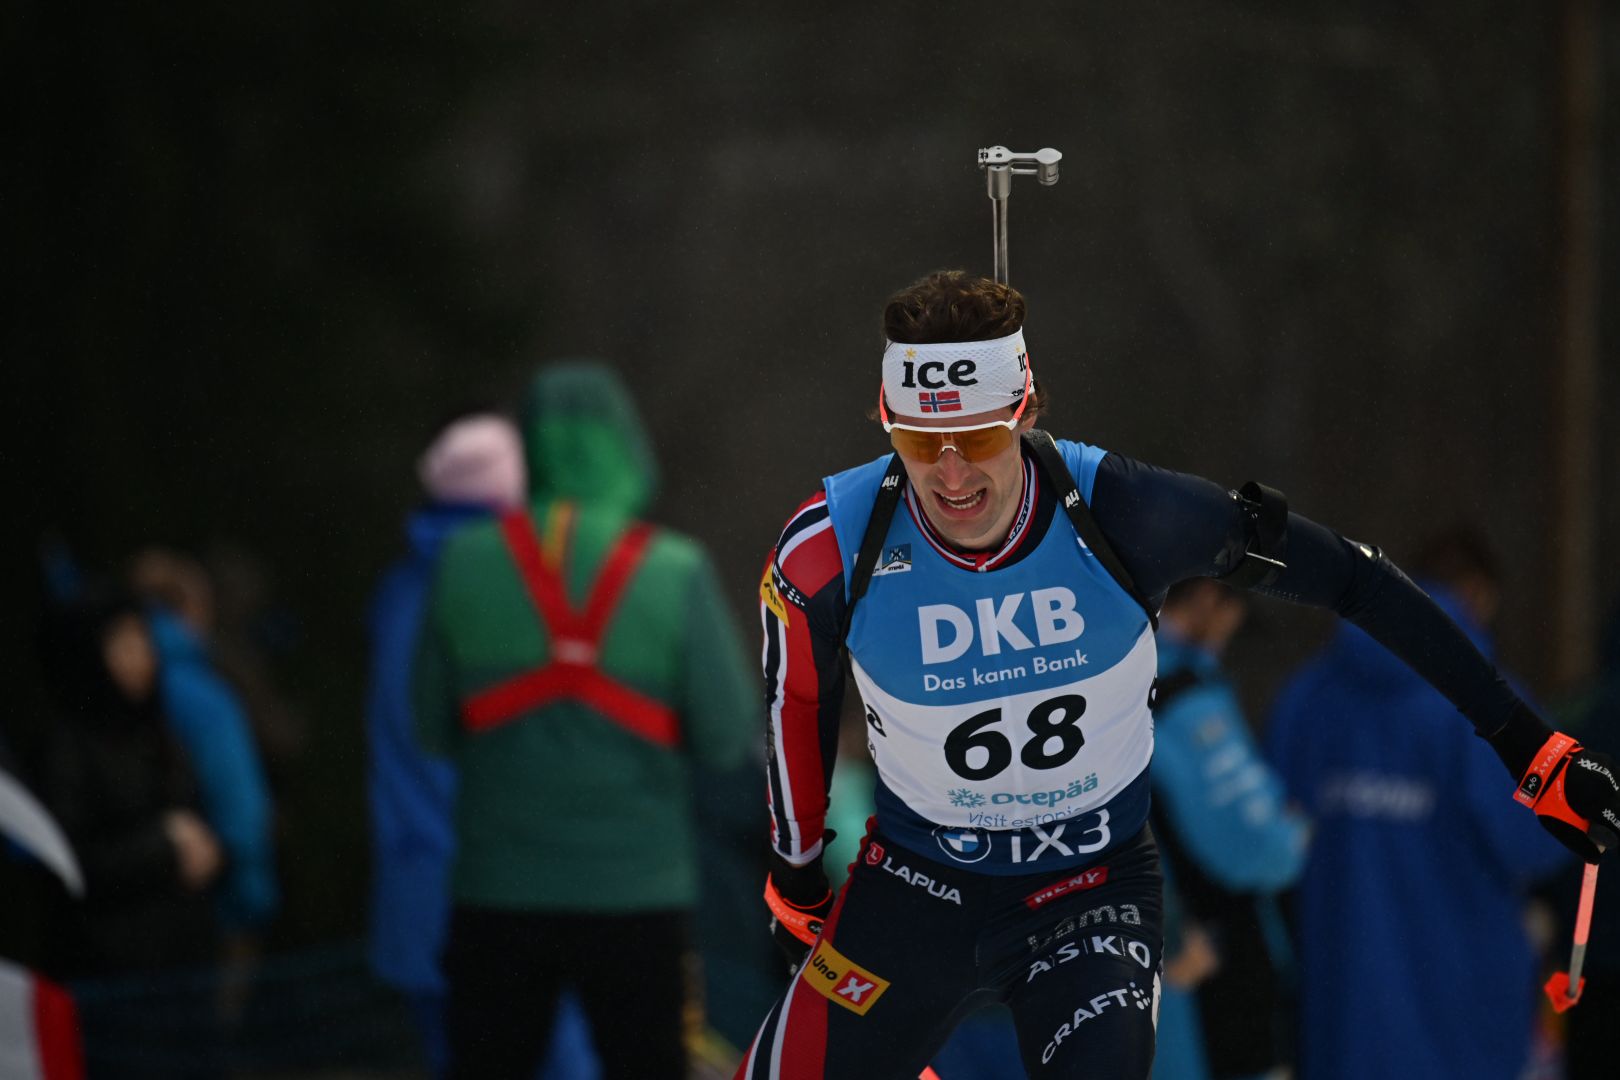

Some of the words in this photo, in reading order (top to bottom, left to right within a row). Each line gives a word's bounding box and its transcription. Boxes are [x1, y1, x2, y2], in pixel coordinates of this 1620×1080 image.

[902, 359, 978, 389] ice
[917, 586, 1085, 665] DKB
[924, 674, 966, 692] Das
[973, 667, 1026, 686] kann
[1032, 649, 1089, 675] Bank
[943, 694, 1087, 779] 68
[969, 812, 1008, 828] visit
[882, 856, 962, 905] LAPUA
[812, 955, 838, 981] Uno
[836, 977, 874, 1002] X
[1042, 988, 1129, 1064] CRAFT
